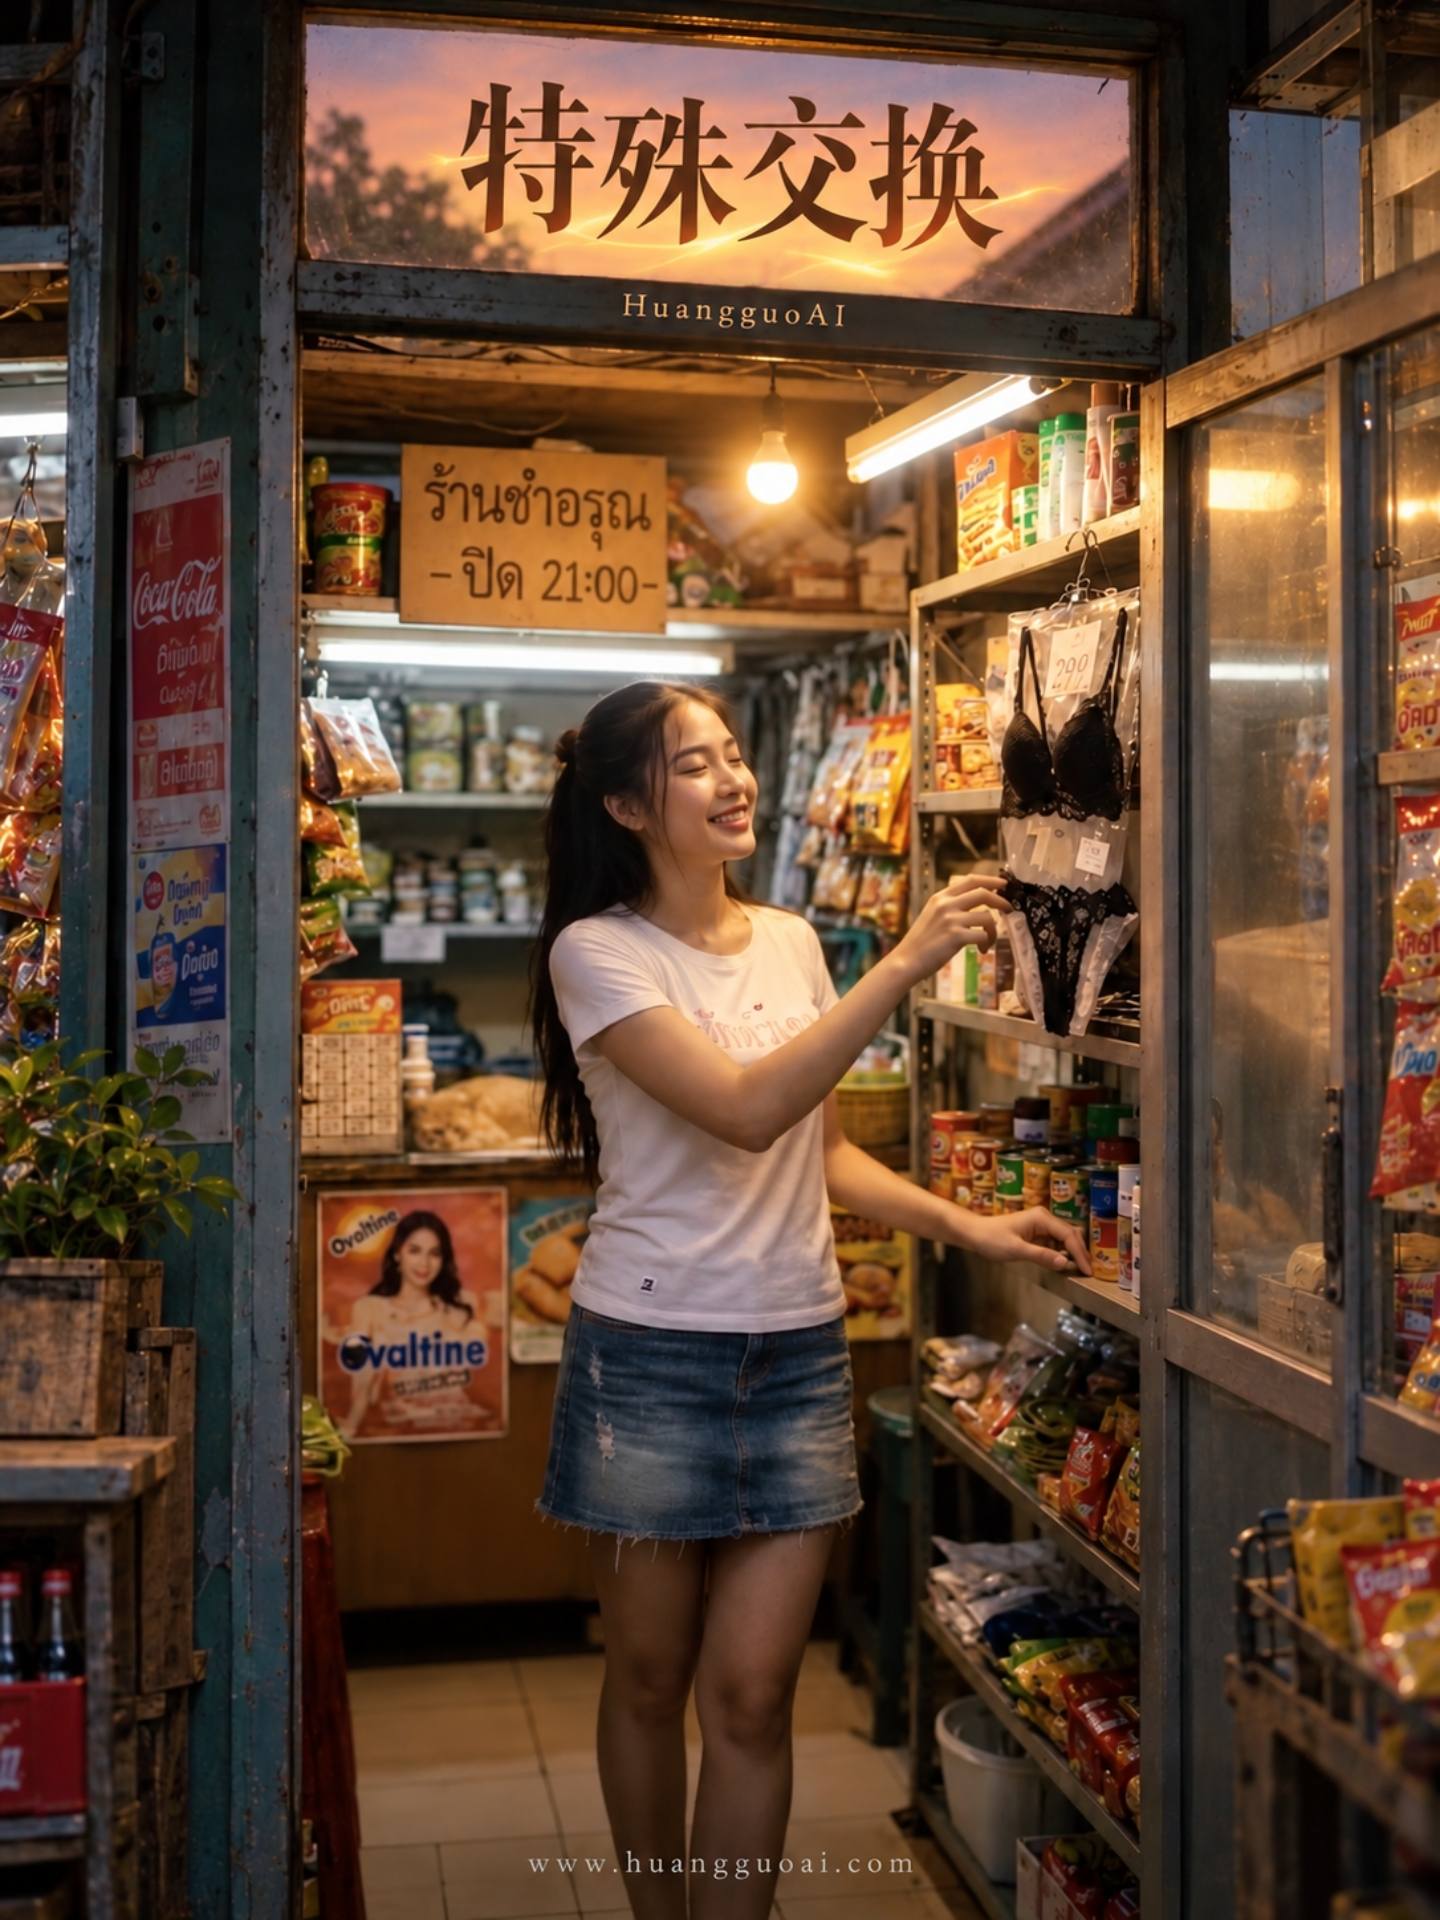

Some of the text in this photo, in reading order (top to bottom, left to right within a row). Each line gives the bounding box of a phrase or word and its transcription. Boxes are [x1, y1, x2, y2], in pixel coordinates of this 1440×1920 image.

[460, 81, 1003, 250] 特殊交换
[622, 293, 846, 329] HuangguoAI
[424, 462, 652, 551] ร้านชำอรุณ
[133, 555, 222, 630] Coca-Cola
[331, 1209, 398, 1256] Ovaltine
